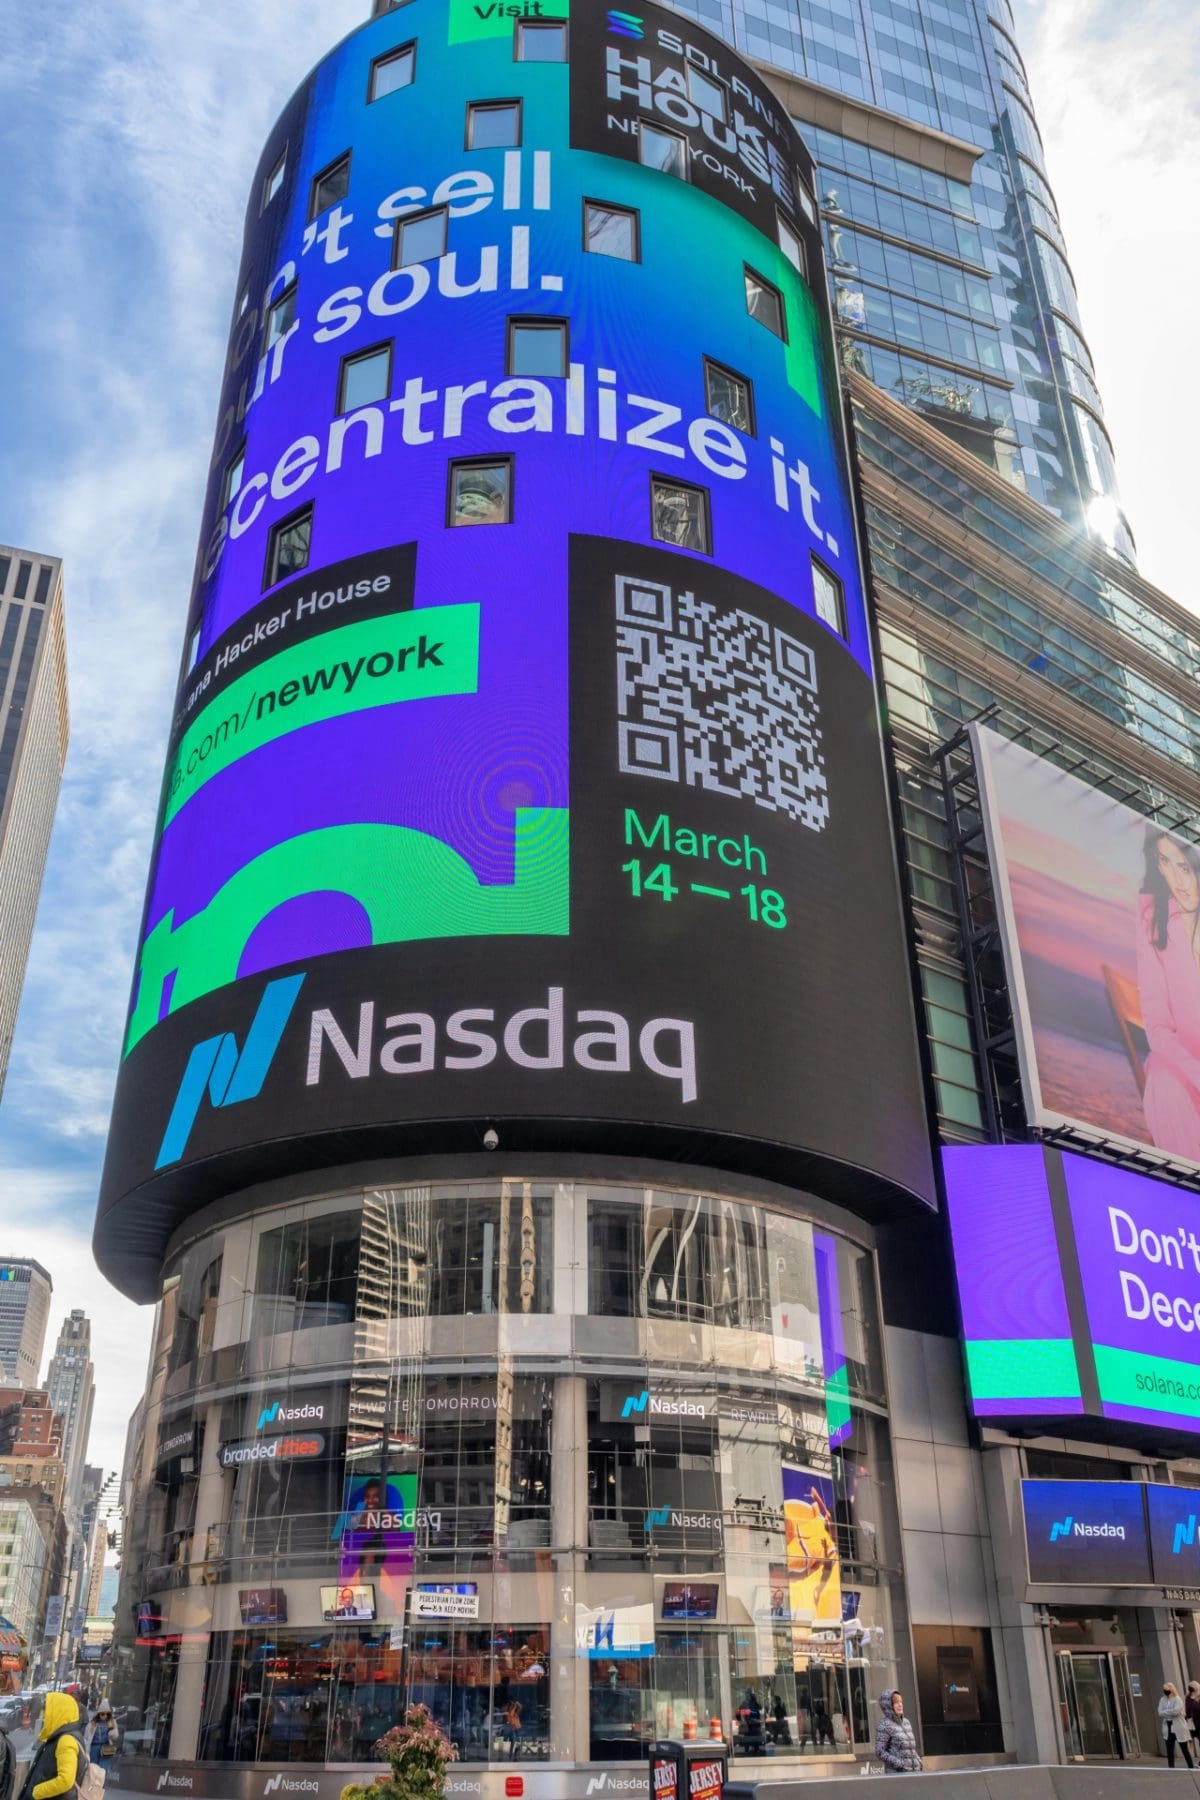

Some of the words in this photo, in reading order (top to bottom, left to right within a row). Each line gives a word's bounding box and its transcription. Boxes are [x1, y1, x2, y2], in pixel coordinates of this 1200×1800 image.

[473, 0, 543, 19] Visit
[658, 29, 791, 151] SOLANA
[606, 46, 791, 180] HAKE
[606, 72, 795, 216] HOUSE
[607, 114, 638, 136] NE
[689, 146, 756, 202] YORK
[374, 151, 551, 239] sell
[313, 225, 563, 344] soul.
[200, 363, 747, 583] ecentralize
[769, 436, 839, 558] it.
[215, 608, 291, 676] Hacker
[296, 573, 392, 621] House
[624, 808, 768, 876] March
[622, 859, 679, 902] 14
[741, 884, 787, 929] 18
[306, 986, 698, 1104] Nasdaq
[1108, 1206, 1200, 1274] Don't
[278, 1403, 324, 1421] Nasdaq
[420, 1397, 503, 1411] TOMORROW
[650, 1398, 705, 1421] Nasdaq
[731, 1408, 783, 1425] REWRIT
[223, 1436, 319, 1464] brandedcities
[366, 1509, 442, 1531] Nasdaq
[671, 1511, 722, 1533] Nasdaq
[1074, 1522, 1126, 1541] Nasdaq
[168, 1775, 193, 1789] Nasdaq
[282, 1779, 319, 1793] Nasdaq
[443, 1779, 481, 1794] asdaq
[654, 1762, 677, 1791] JERSEY
[690, 1760, 723, 1794] JERSEY
